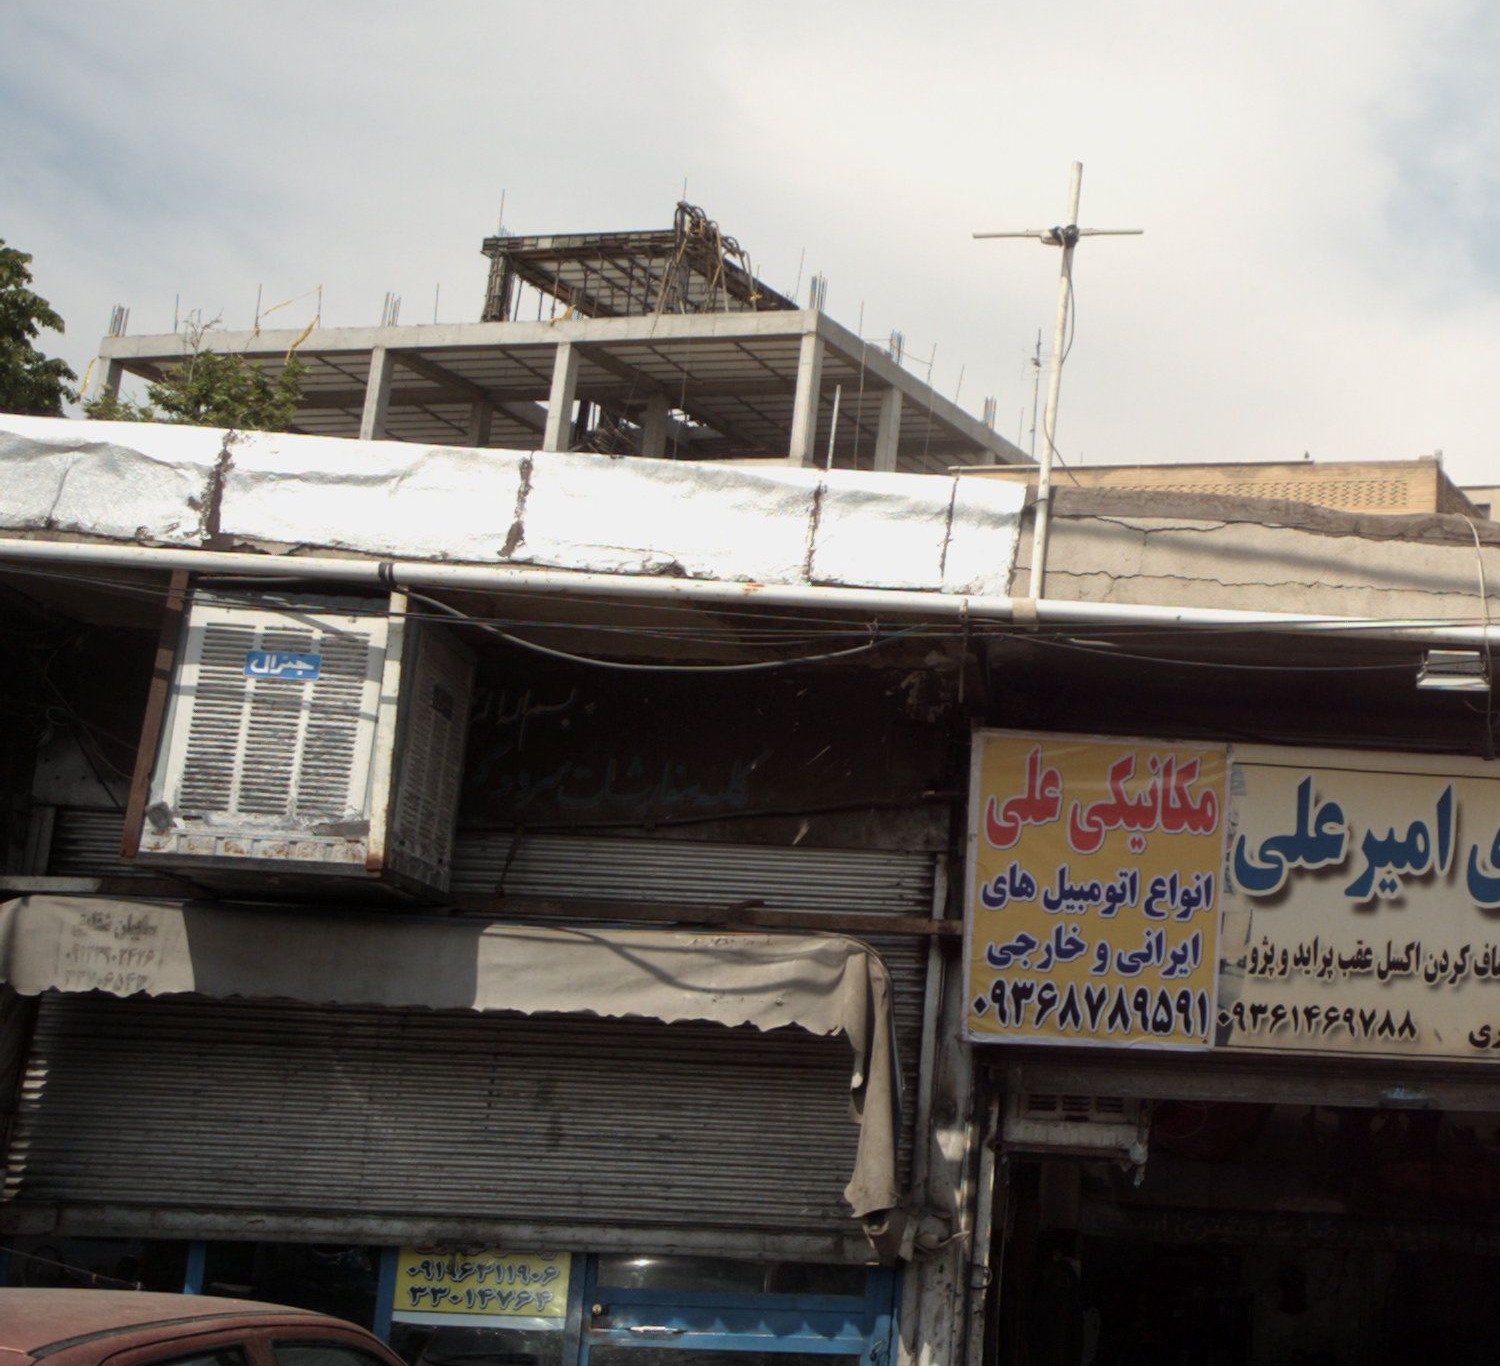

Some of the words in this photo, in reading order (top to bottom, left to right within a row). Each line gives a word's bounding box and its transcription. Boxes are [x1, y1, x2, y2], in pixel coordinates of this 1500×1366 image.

[250, 654, 314, 676] جنرال
[985, 744, 1062, 848] علی
[1069, 753, 1217, 851] مکانیکی
[982, 862, 1036, 909] های
[1043, 866, 1138, 916] اتومبیل
[1143, 873, 1213, 919] انواع
[986, 923, 1087, 971] خارجی
[1092, 941, 1109, 974] و
[1115, 929, 1200, 977] ایرانی
[1248, 935, 1275, 976] پژو
[1278, 946, 1289, 976] و
[1293, 936, 1333, 978] پراید
[1338, 939, 1373, 977] عقب
[1376, 940, 1421, 980] اکسل
[1423, 943, 1471, 984] کردن
[973, 979, 1207, 1034] ۰۹۳۶۸۷۸۹۵۹۱
[1217, 1001, 1417, 1038] ۰۹۳۶۱۴۶۹۷۸۸
